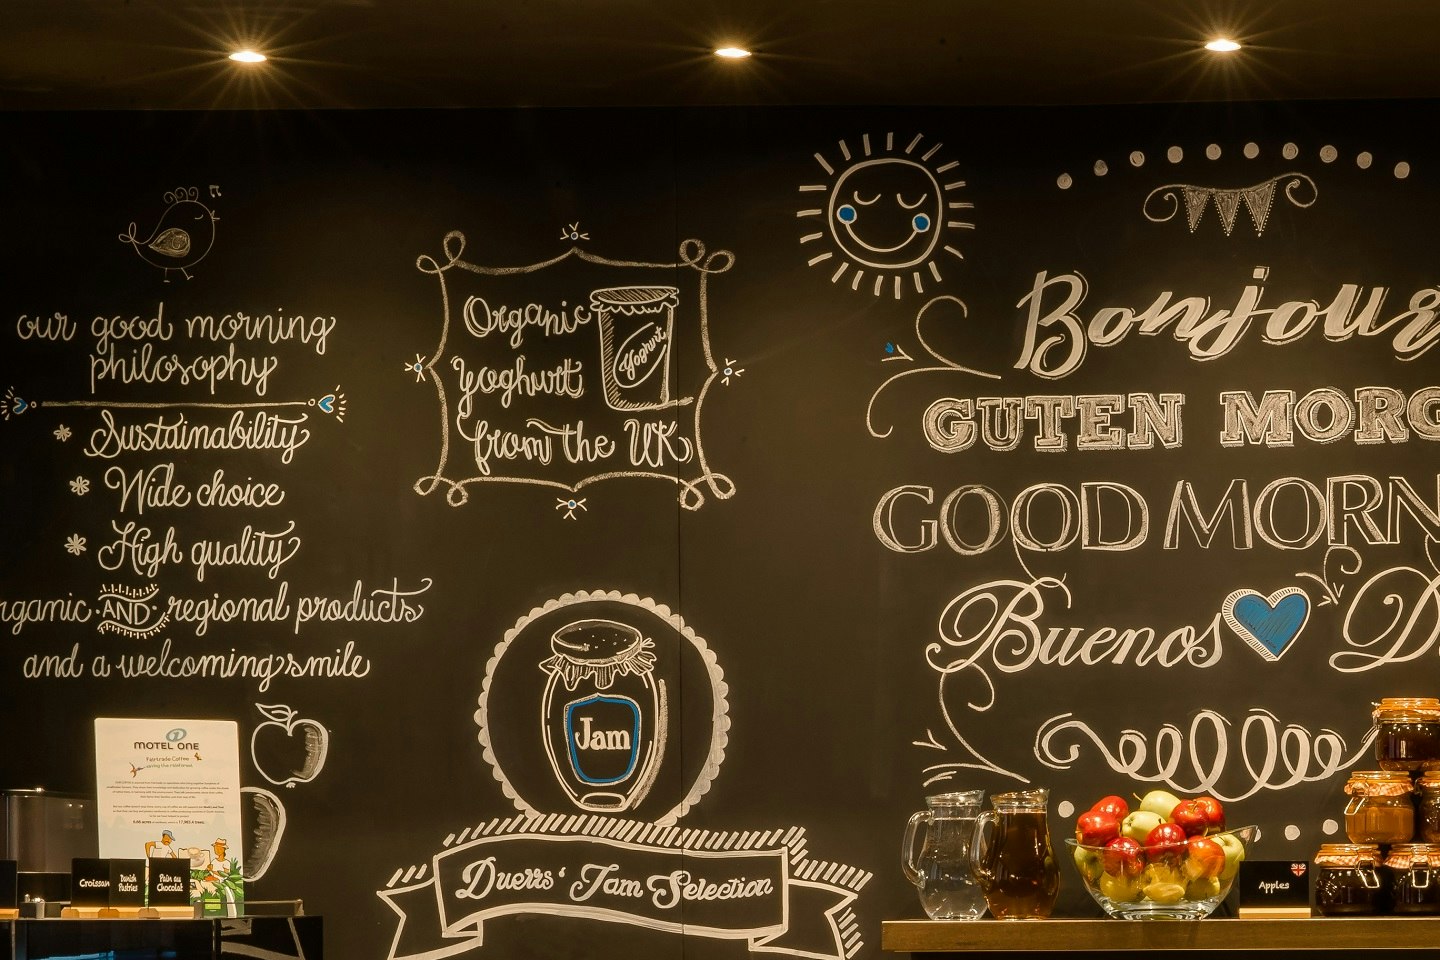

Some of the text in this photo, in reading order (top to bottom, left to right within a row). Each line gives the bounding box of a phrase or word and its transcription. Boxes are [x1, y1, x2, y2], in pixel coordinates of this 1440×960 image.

[17, 302, 336, 354] our good morning
[463, 295, 592, 349] Organic
[90, 343, 278, 396] philosophy
[83, 410, 311, 464] Sustainability
[457, 412, 694, 476] from the UK
[923, 392, 1186, 453] GUTEN
[105, 463, 286, 514] Wide choice
[872, 482, 1150, 553] GOOD
[98, 520, 301, 582] High quality
[0, 577, 433, 637] rganic AND regional products
[925, 574, 1225, 675] Buenos
[23, 638, 371, 692] and a welcoming smile
[134, 741, 200, 750] MOTEL ONE
[574, 717, 631, 751] Jam
[79, 879, 110, 888] Croissan
[569, 863, 644, 902] Jam
[646, 871, 774, 910] Selection
[1258, 881, 1290, 893] Apples
